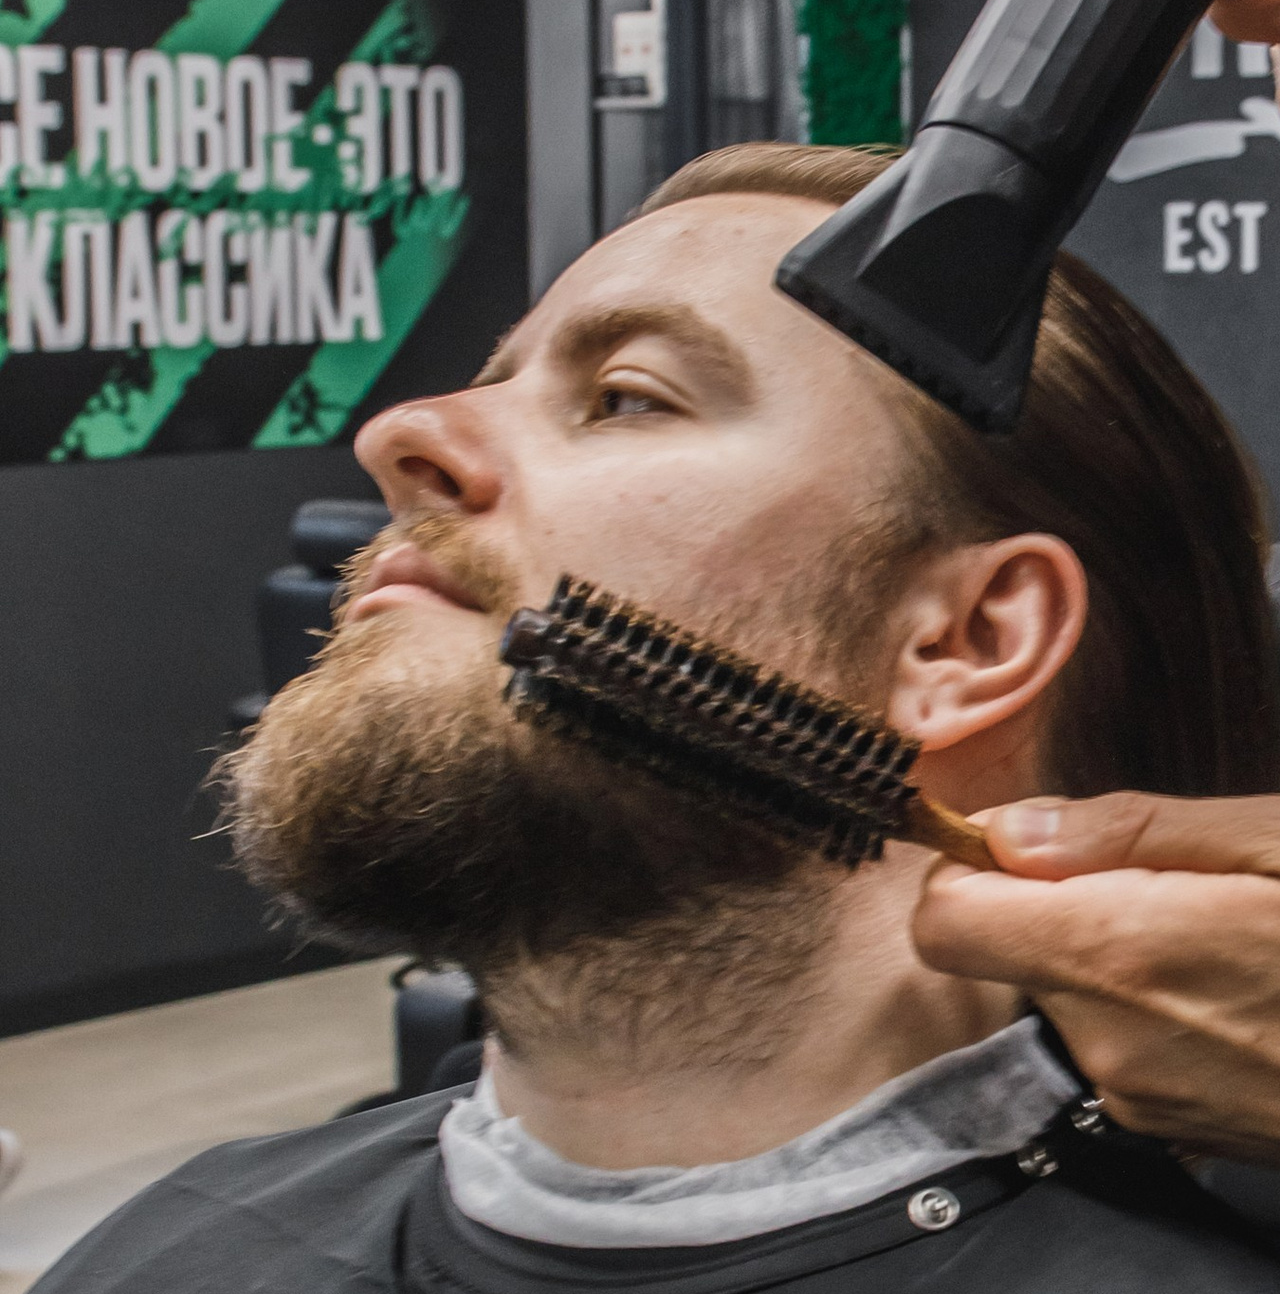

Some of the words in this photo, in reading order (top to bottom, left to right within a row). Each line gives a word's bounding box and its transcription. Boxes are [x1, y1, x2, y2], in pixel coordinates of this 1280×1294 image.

[73, 46, 312, 193] НОВОЕ
[336, 61, 465, 195] ЭТО
[5, 207, 383, 354] КЛАССИКА
[1163, 200, 1269, 274] EST
